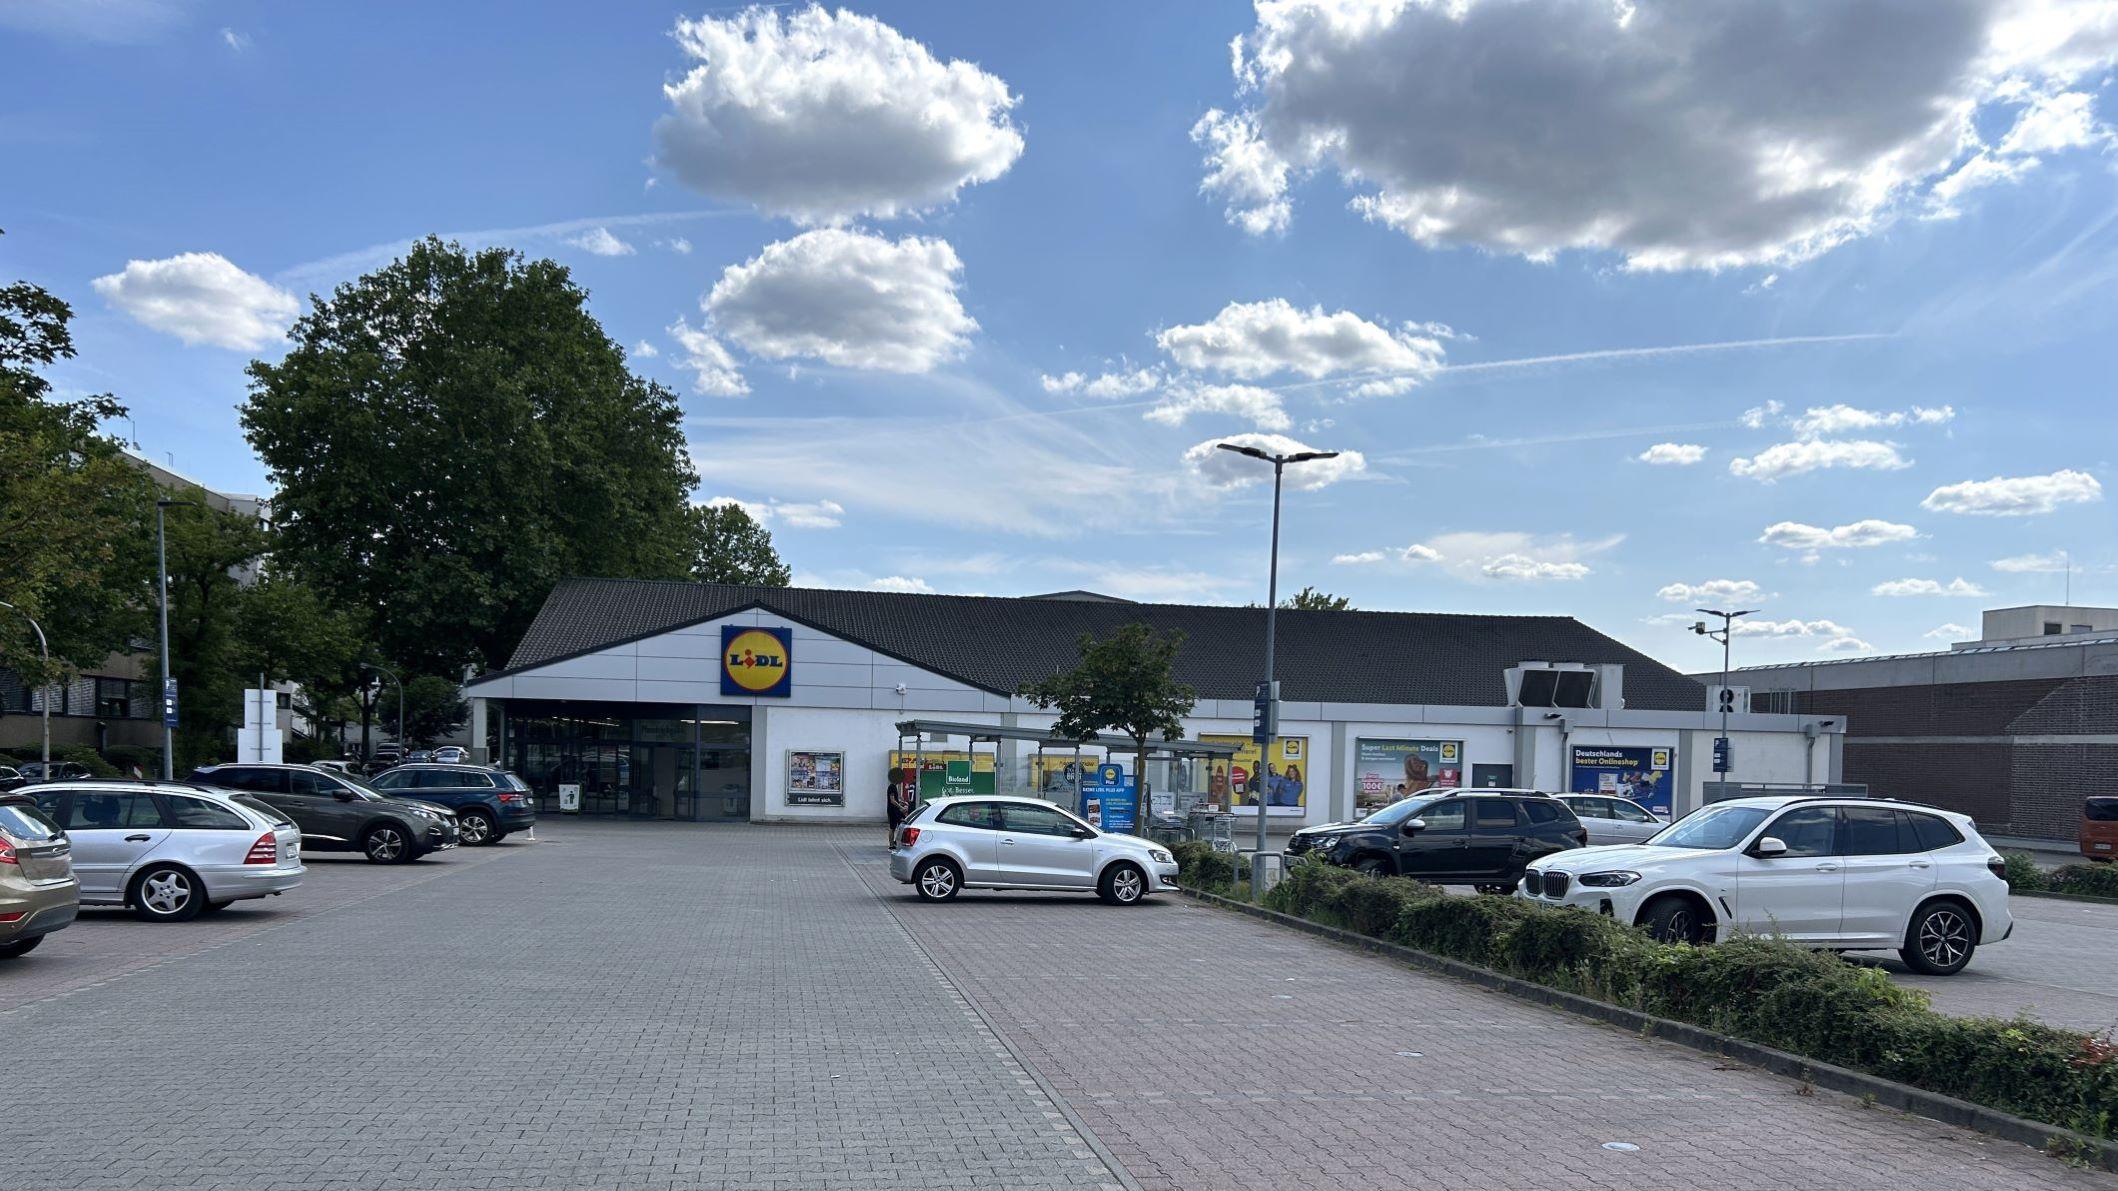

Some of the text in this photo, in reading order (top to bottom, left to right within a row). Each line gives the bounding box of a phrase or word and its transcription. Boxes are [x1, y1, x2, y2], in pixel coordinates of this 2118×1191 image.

[1361, 743, 1381, 752] Super
[1575, 749, 1622, 757] Deutschlands
[1599, 758, 1639, 766] Onlineshop
